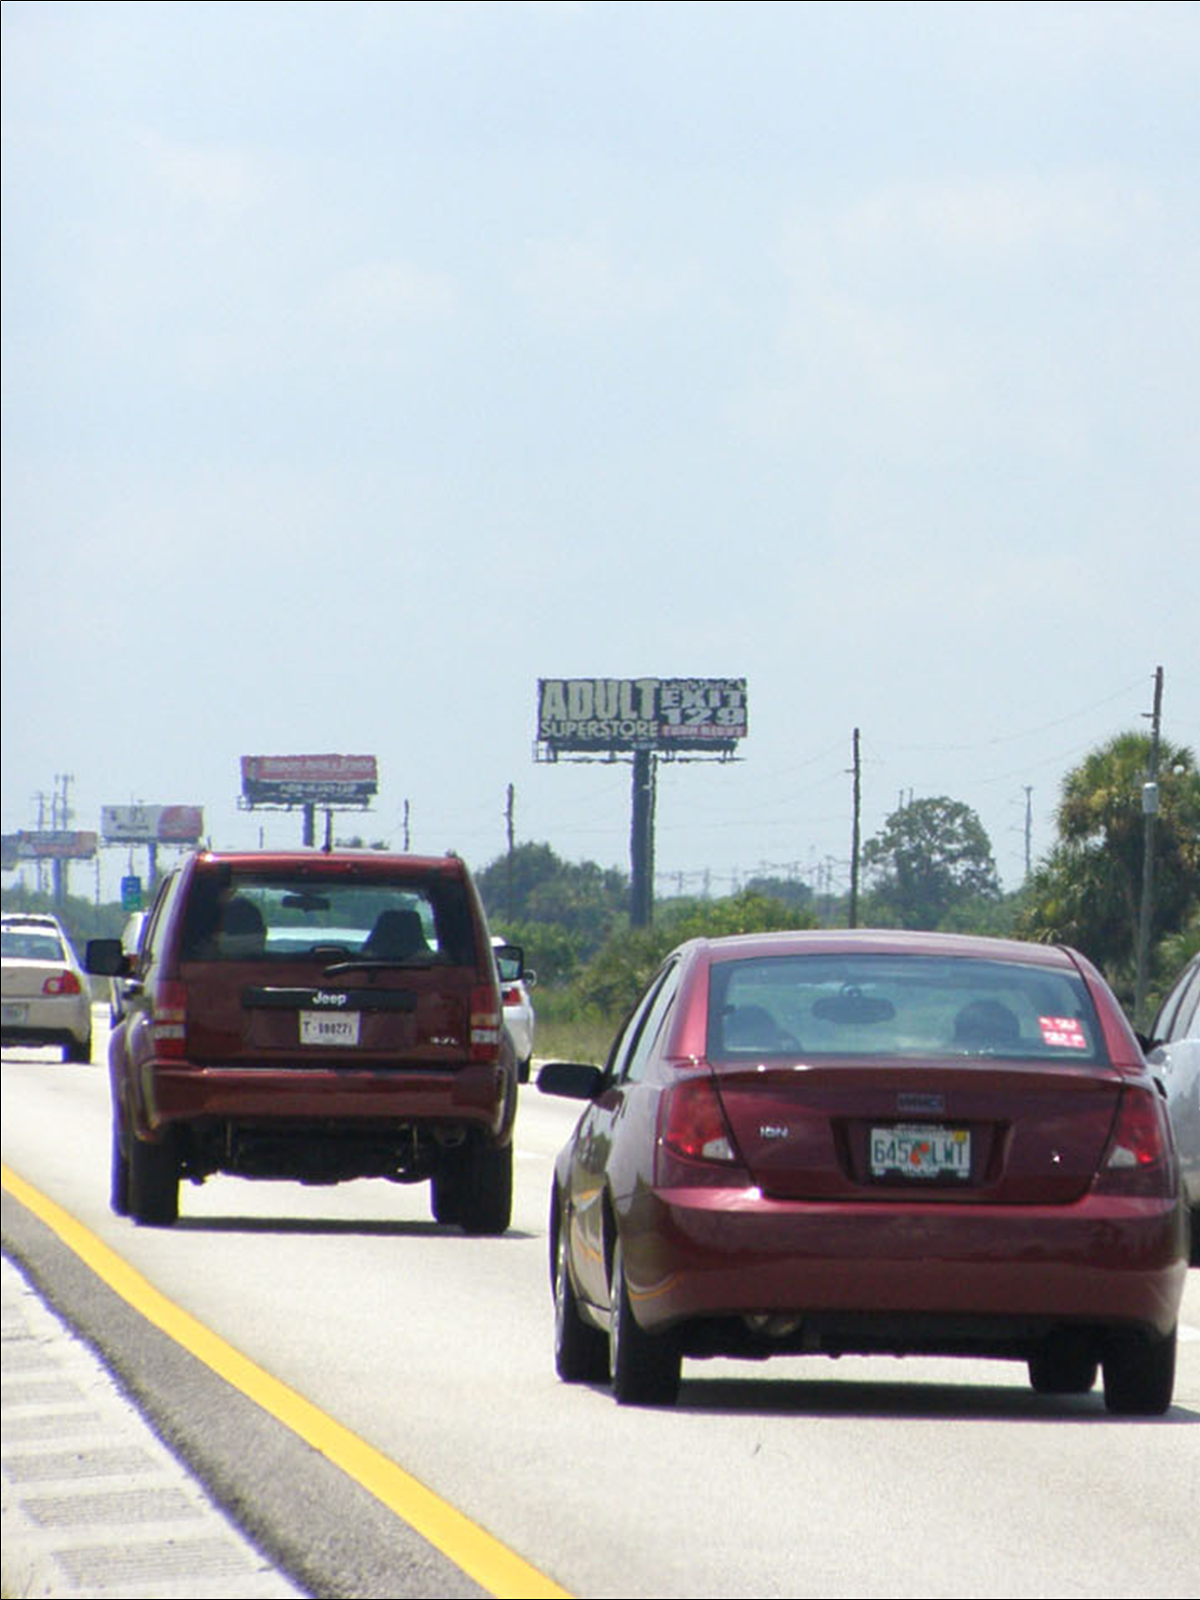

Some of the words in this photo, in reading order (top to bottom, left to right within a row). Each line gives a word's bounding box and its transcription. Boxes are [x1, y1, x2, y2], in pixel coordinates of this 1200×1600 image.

[542, 679, 660, 721] ADULT
[660, 689, 742, 708] EXIT
[540, 720, 659, 738] SUPERSTORE
[312, 991, 347, 1006] Jeep
